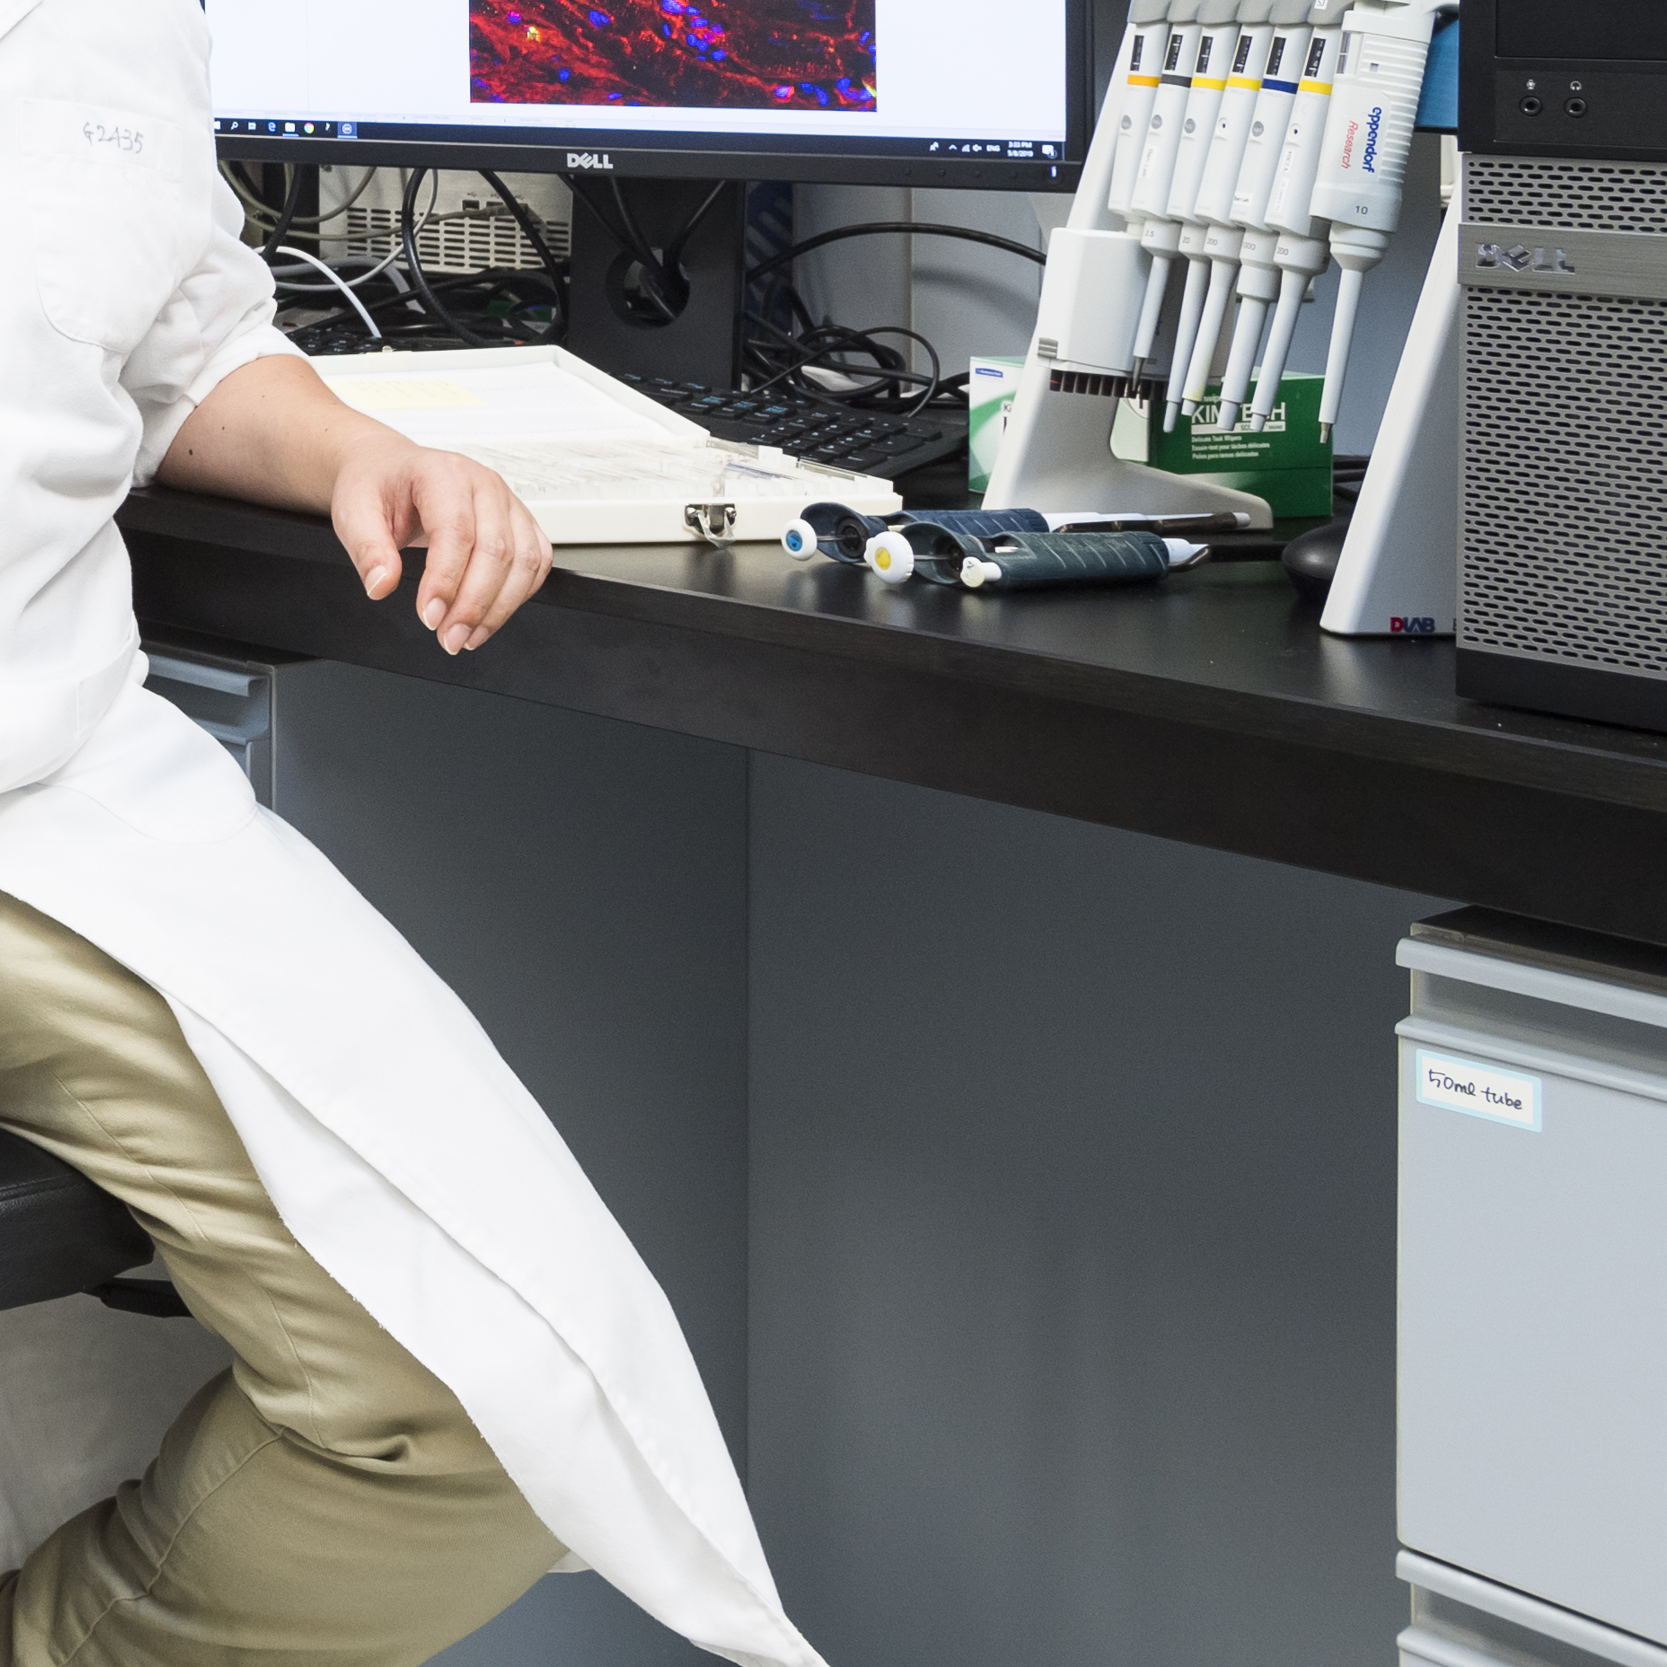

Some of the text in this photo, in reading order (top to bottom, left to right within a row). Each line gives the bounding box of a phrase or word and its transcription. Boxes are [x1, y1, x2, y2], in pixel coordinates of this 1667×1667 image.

[1021, 141, 1033, 149] PM
[1341, 120, 1359, 169] Research
[1362, 106, 1382, 173] eppendorf
[986, 144, 1001, 153] ENG
[566, 152, 614, 170] DELL
[1354, 205, 1368, 215] 10
[1276, 246, 1289, 256] 200
[1475, 243, 1576, 275] DELL
[1390, 616, 1435, 633] DLAB
[1428, 1068, 1522, 1110] 50ml tube
